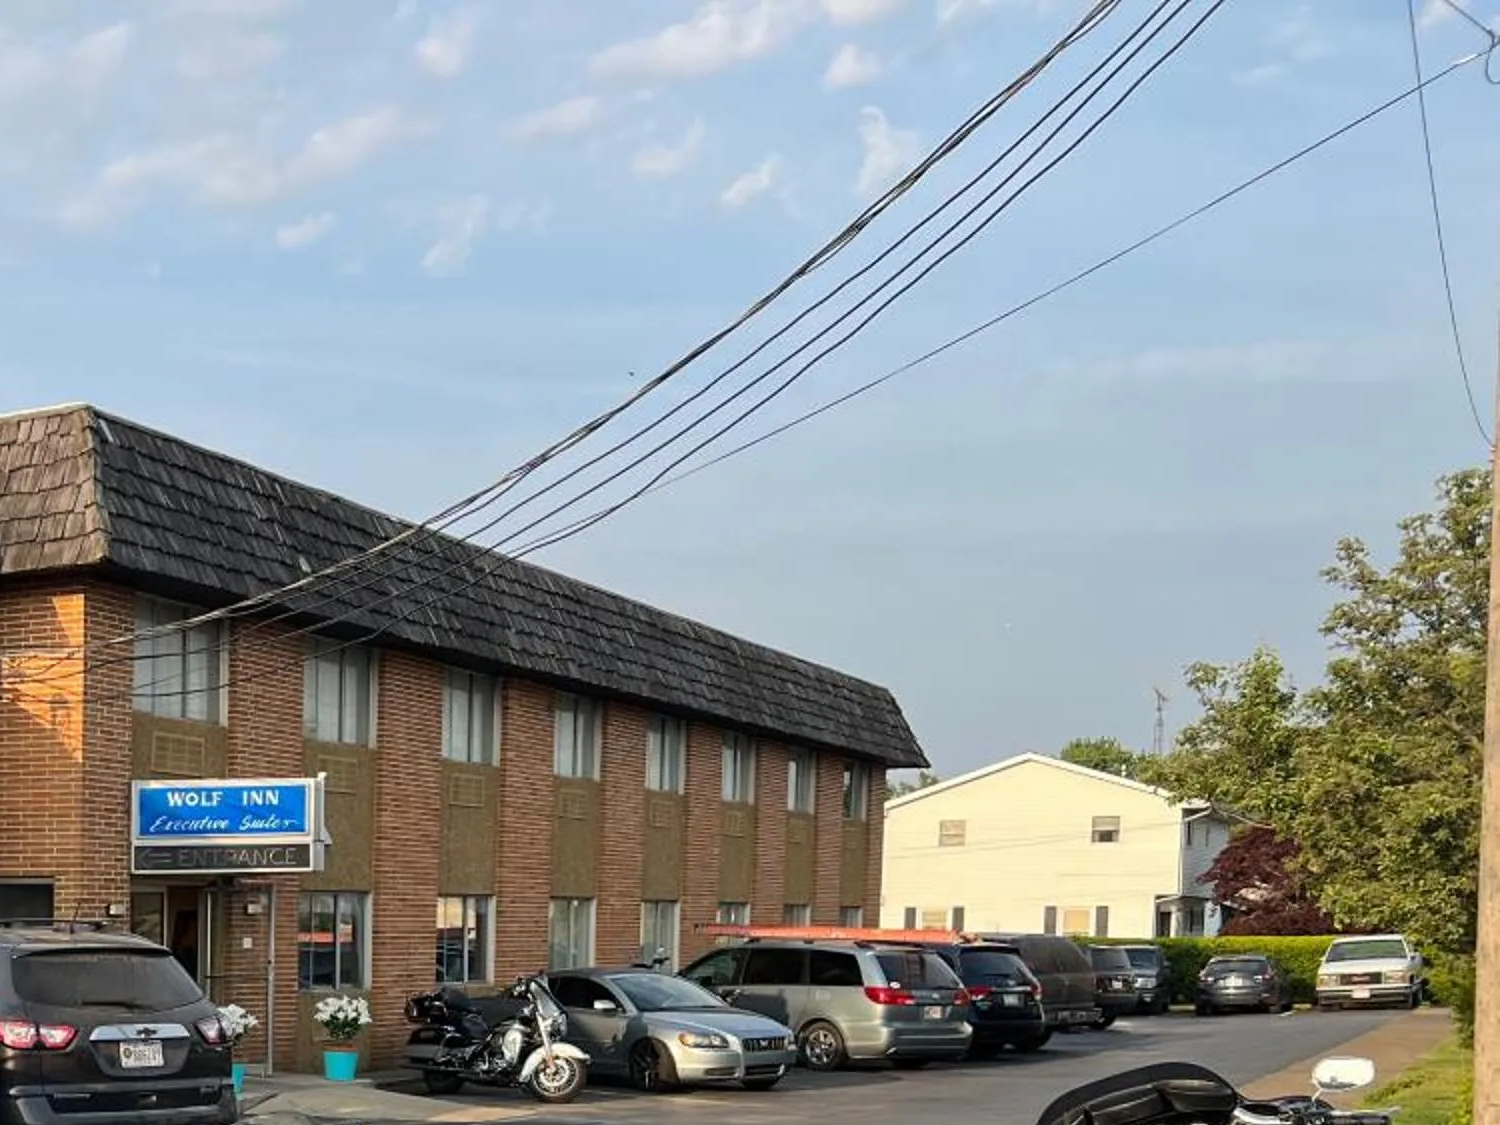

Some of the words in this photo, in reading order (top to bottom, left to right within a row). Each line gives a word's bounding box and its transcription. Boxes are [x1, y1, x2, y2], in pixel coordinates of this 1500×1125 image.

[166, 791, 223, 807] WOLF
[242, 789, 280, 806] INN
[149, 815, 229, 833] Executive
[177, 847, 297, 867] ENTRANCE
